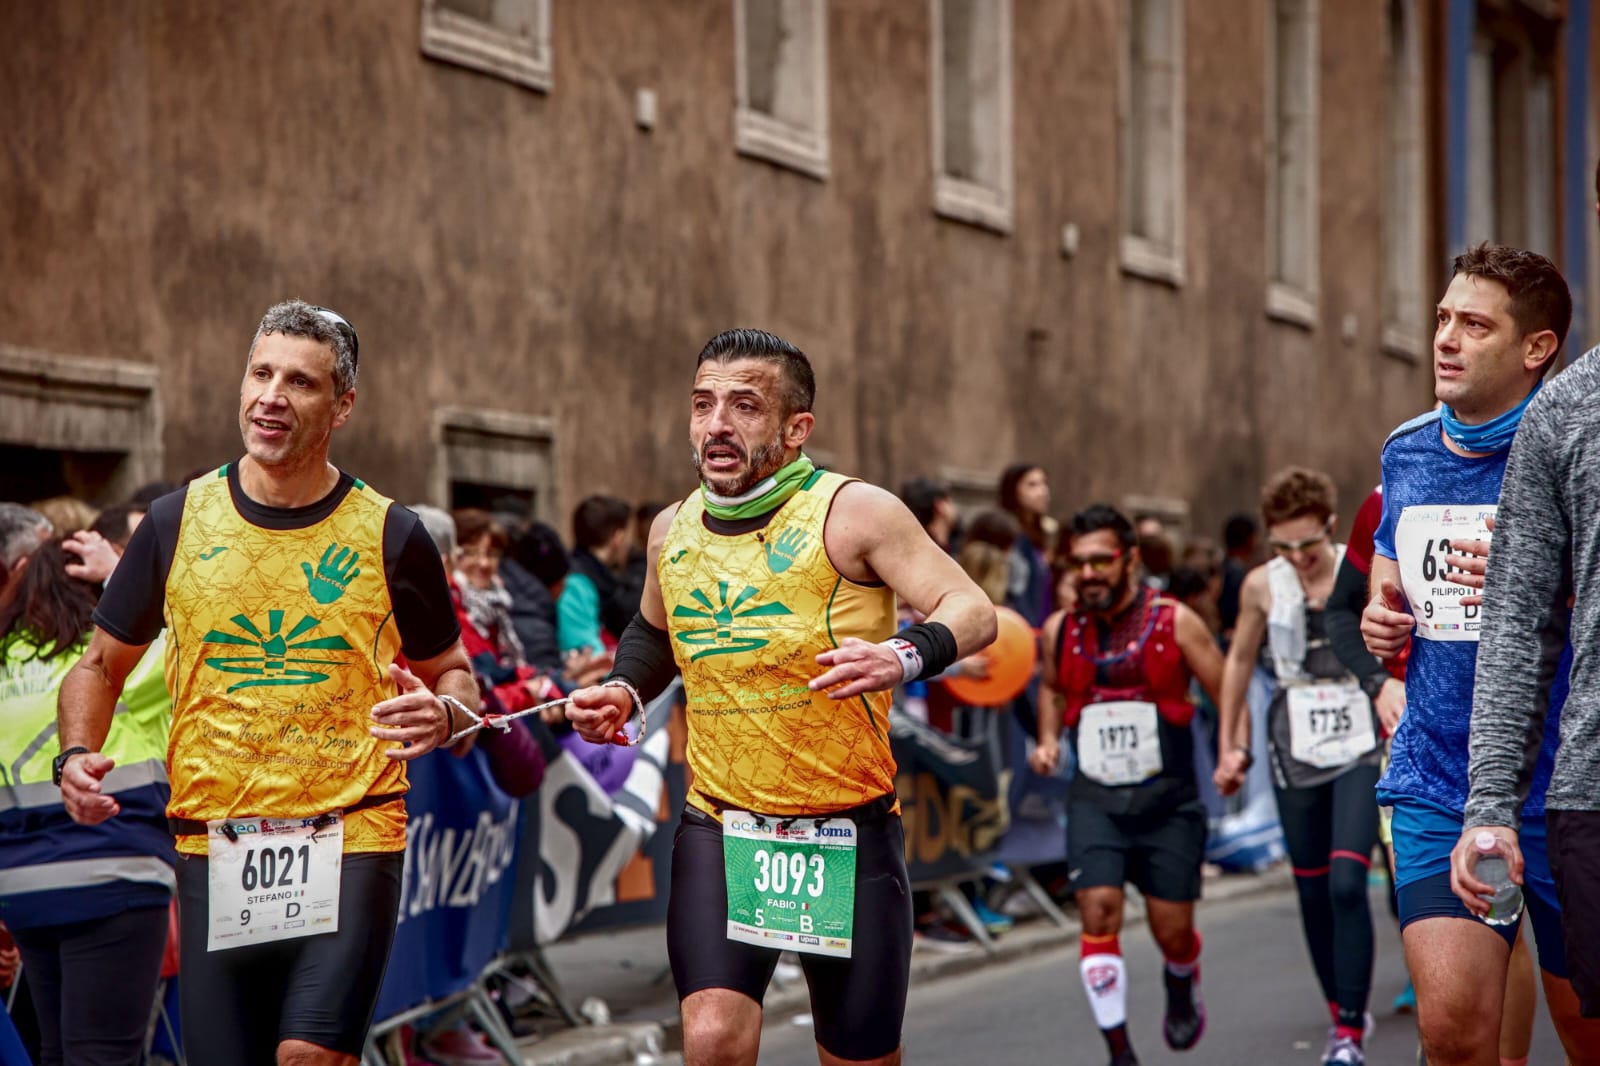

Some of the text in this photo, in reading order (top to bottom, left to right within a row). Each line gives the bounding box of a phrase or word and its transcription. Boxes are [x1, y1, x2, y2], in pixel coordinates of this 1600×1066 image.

[1432, 587, 1465, 596] FILIPPO
[1424, 601, 1434, 619] 9
[1099, 725, 1137, 751] 1973
[815, 826, 853, 838] Joma
[241, 845, 310, 892] 6021
[754, 850, 825, 898] 3093
[247, 891, 292, 905] STEFANO
[767, 899, 797, 910] FABIO
[240, 909, 251, 926] 9
[286, 902, 301, 918] D
[755, 908, 765, 927] 5
[800, 915, 814, 933] B
